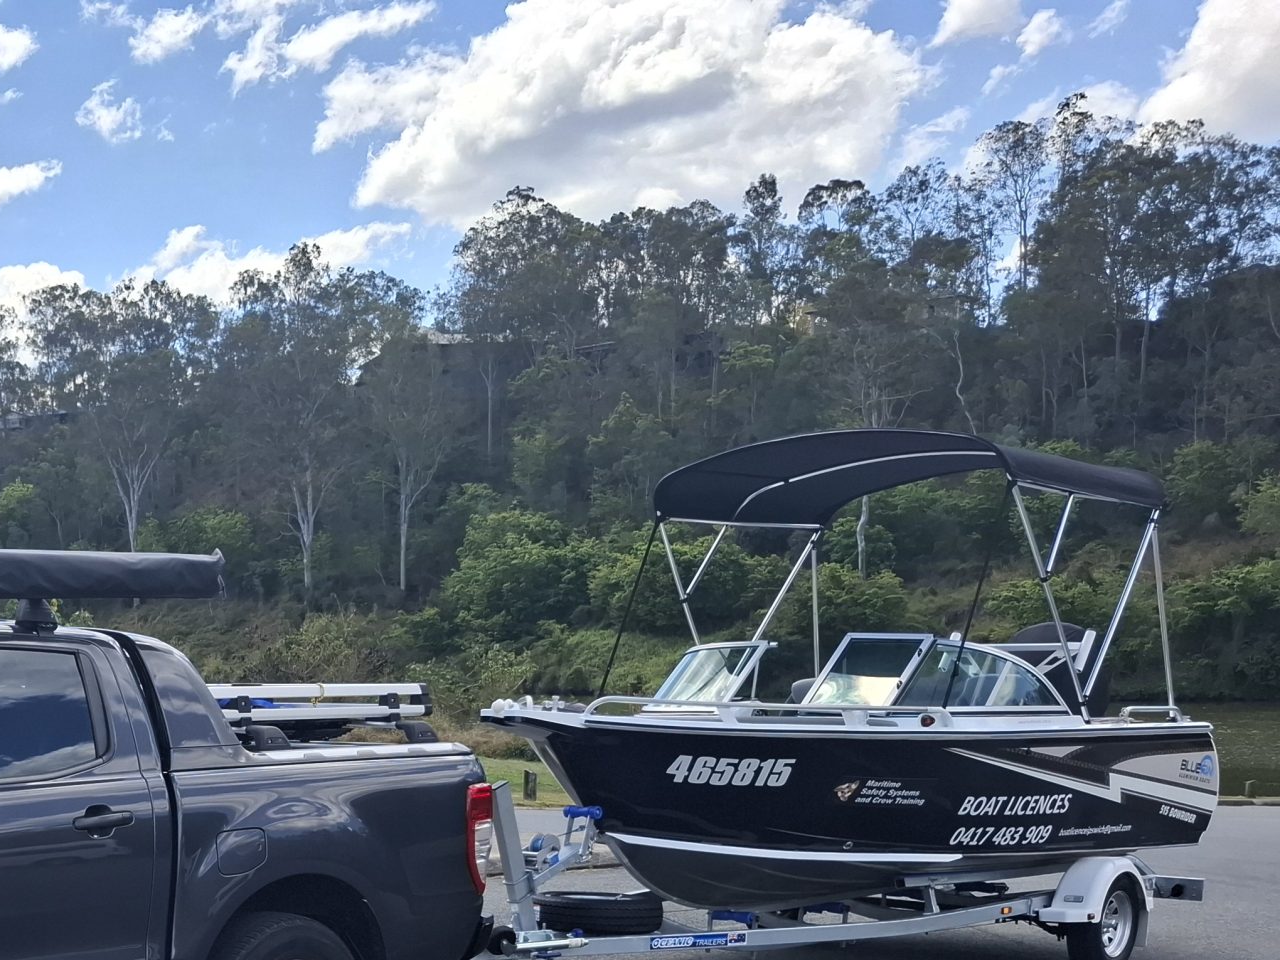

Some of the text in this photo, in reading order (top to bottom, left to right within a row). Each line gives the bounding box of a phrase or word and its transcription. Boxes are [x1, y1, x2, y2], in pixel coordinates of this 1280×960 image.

[665, 754, 797, 787] 465815
[865, 780, 901, 788] Maritime
[860, 788, 920, 797] Safety Systems
[872, 796, 894, 804] Crew
[894, 797, 925, 806] Training
[957, 793, 1072, 816] BOAT LICENCES
[1169, 808, 1197, 823] BOWRIDER
[949, 824, 1053, 846] 0417 483 909
[652, 937, 726, 948] OCEANIC TRAILERS
